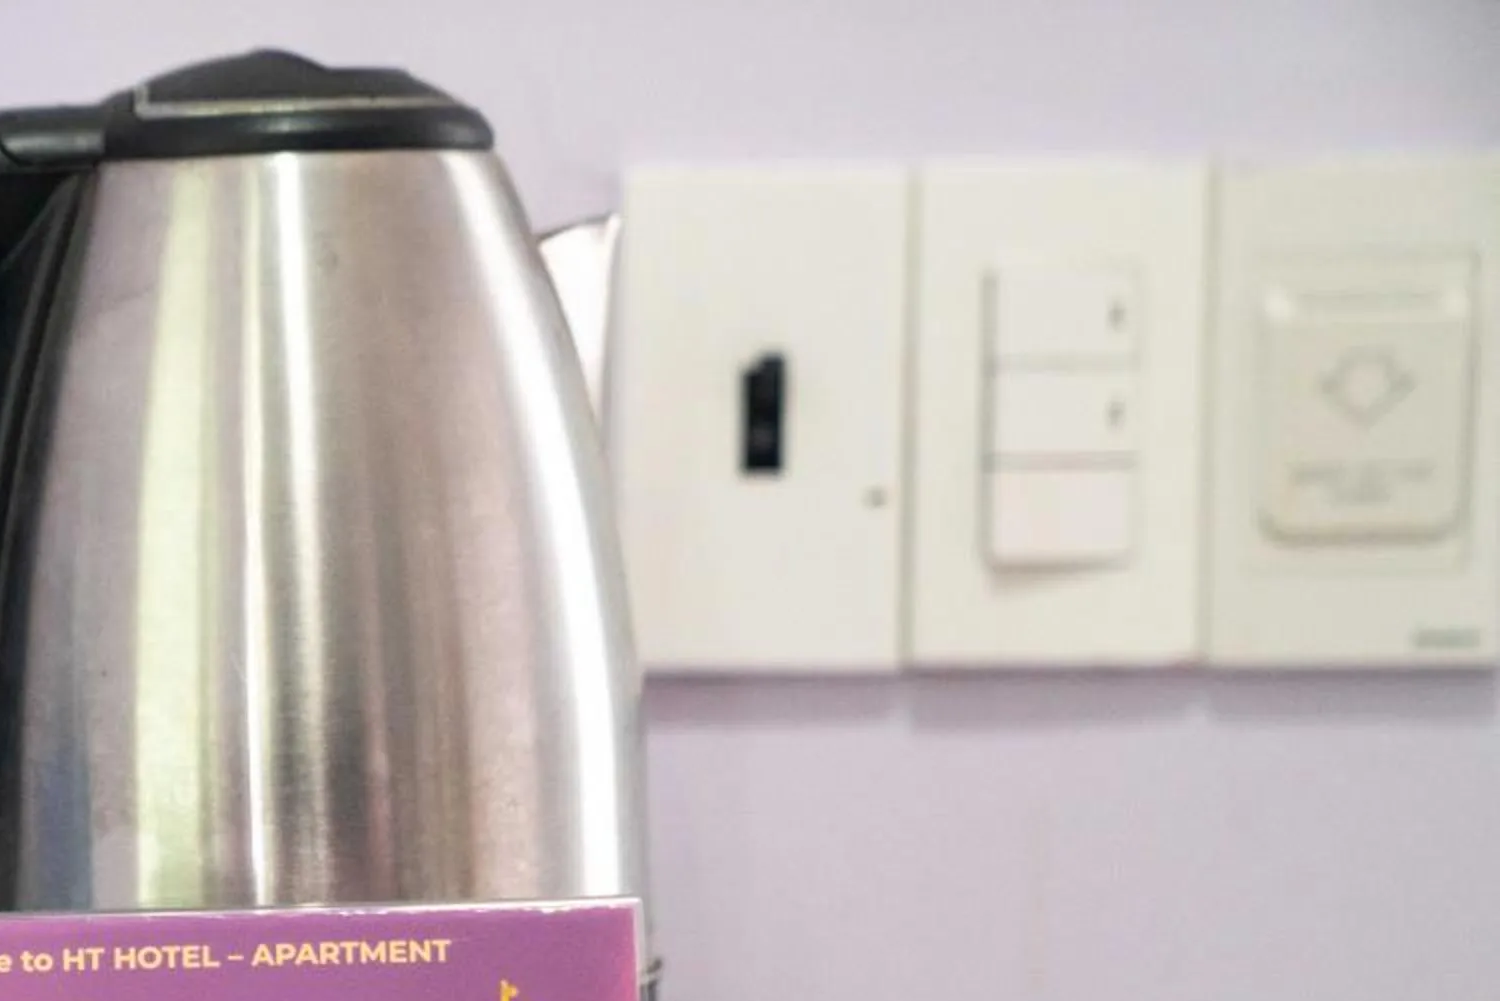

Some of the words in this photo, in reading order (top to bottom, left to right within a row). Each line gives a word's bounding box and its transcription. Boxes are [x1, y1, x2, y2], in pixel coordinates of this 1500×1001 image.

[20, 951, 53, 972] to
[63, 947, 104, 971] HT
[114, 945, 220, 970] HOTEL
[252, 939, 451, 966] APARTMENT
